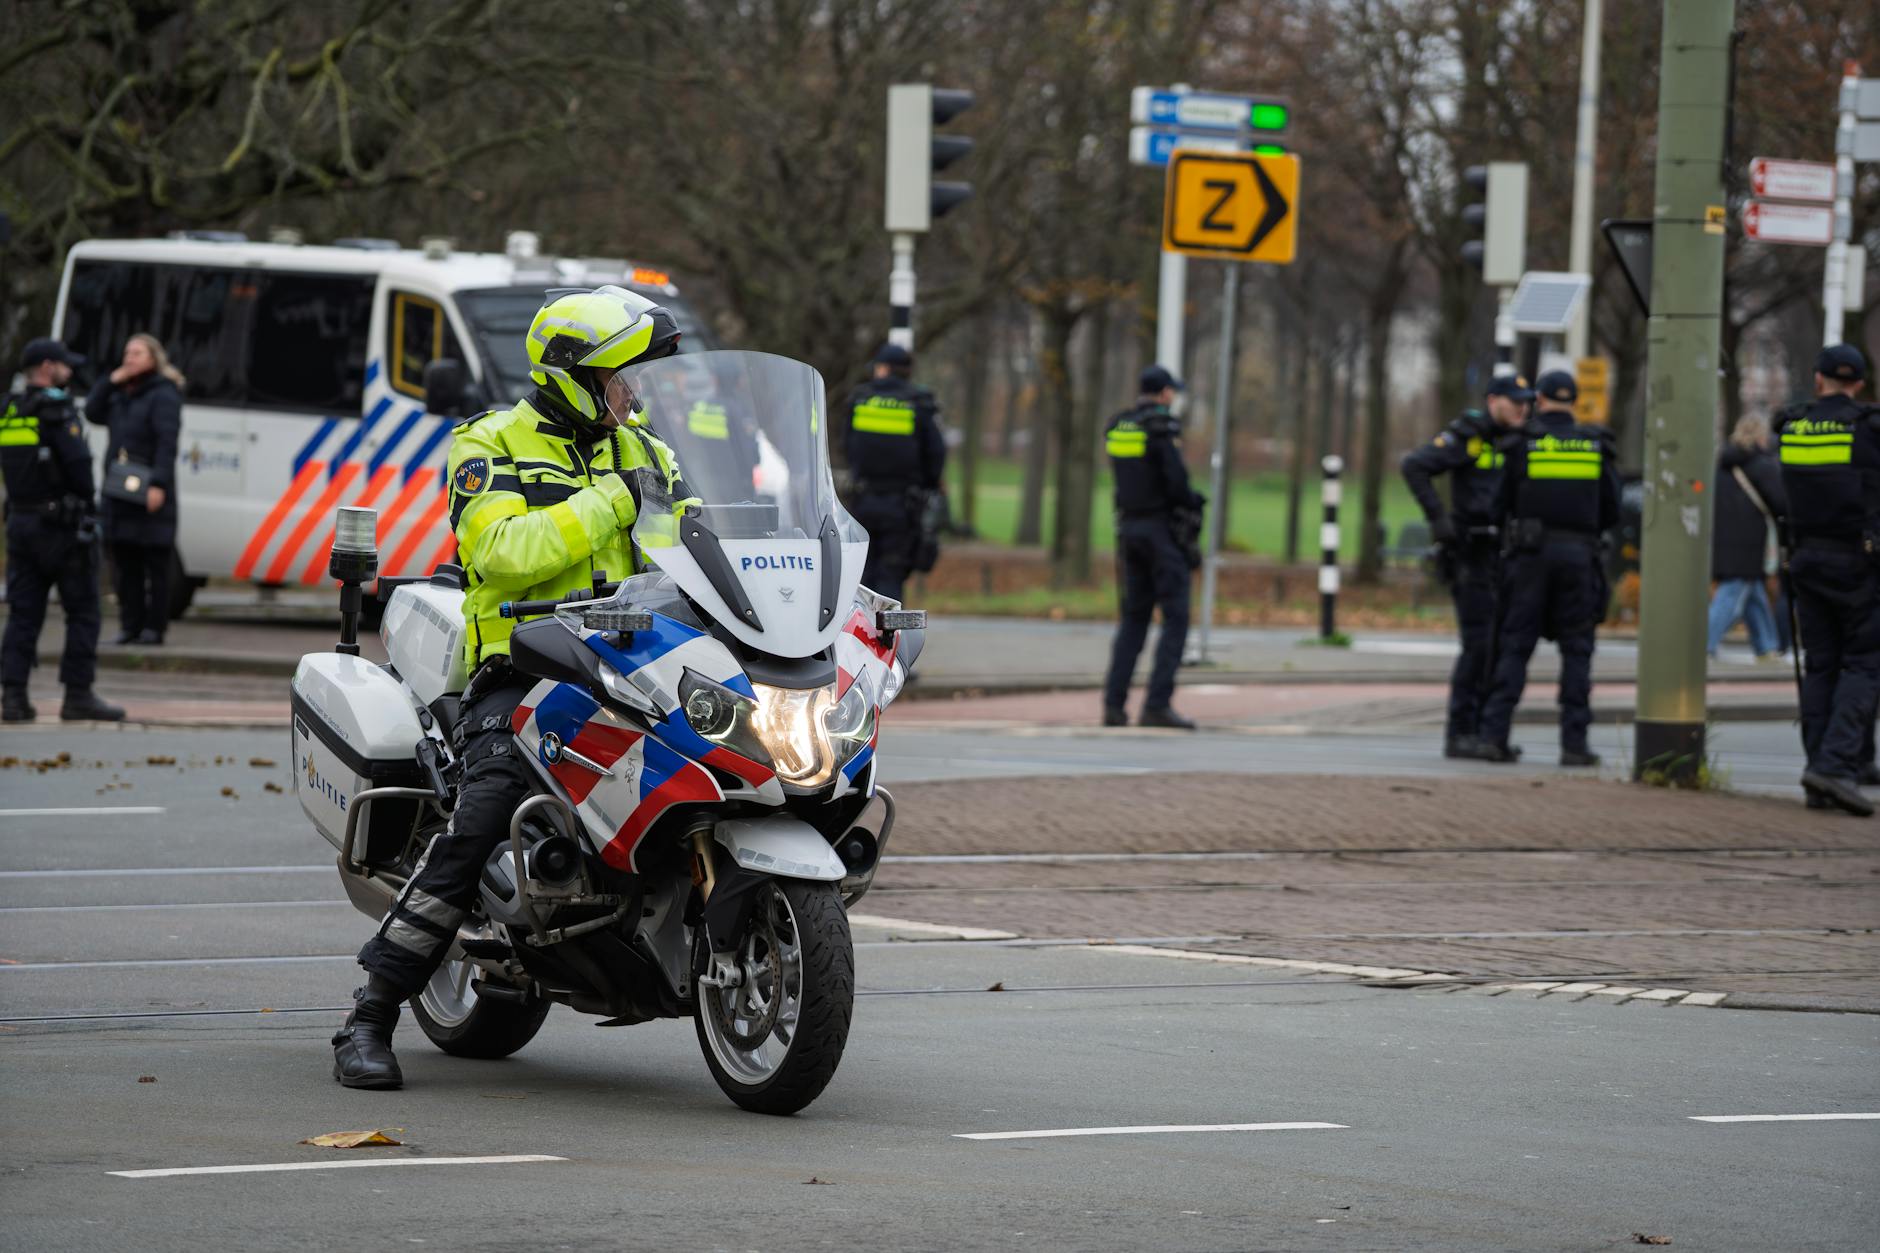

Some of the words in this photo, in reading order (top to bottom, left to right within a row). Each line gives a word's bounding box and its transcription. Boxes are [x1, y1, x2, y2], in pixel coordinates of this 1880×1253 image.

[1202, 181, 1236, 230] Z
[456, 461, 486, 478] PLITIE
[741, 555, 814, 571] POLITIE
